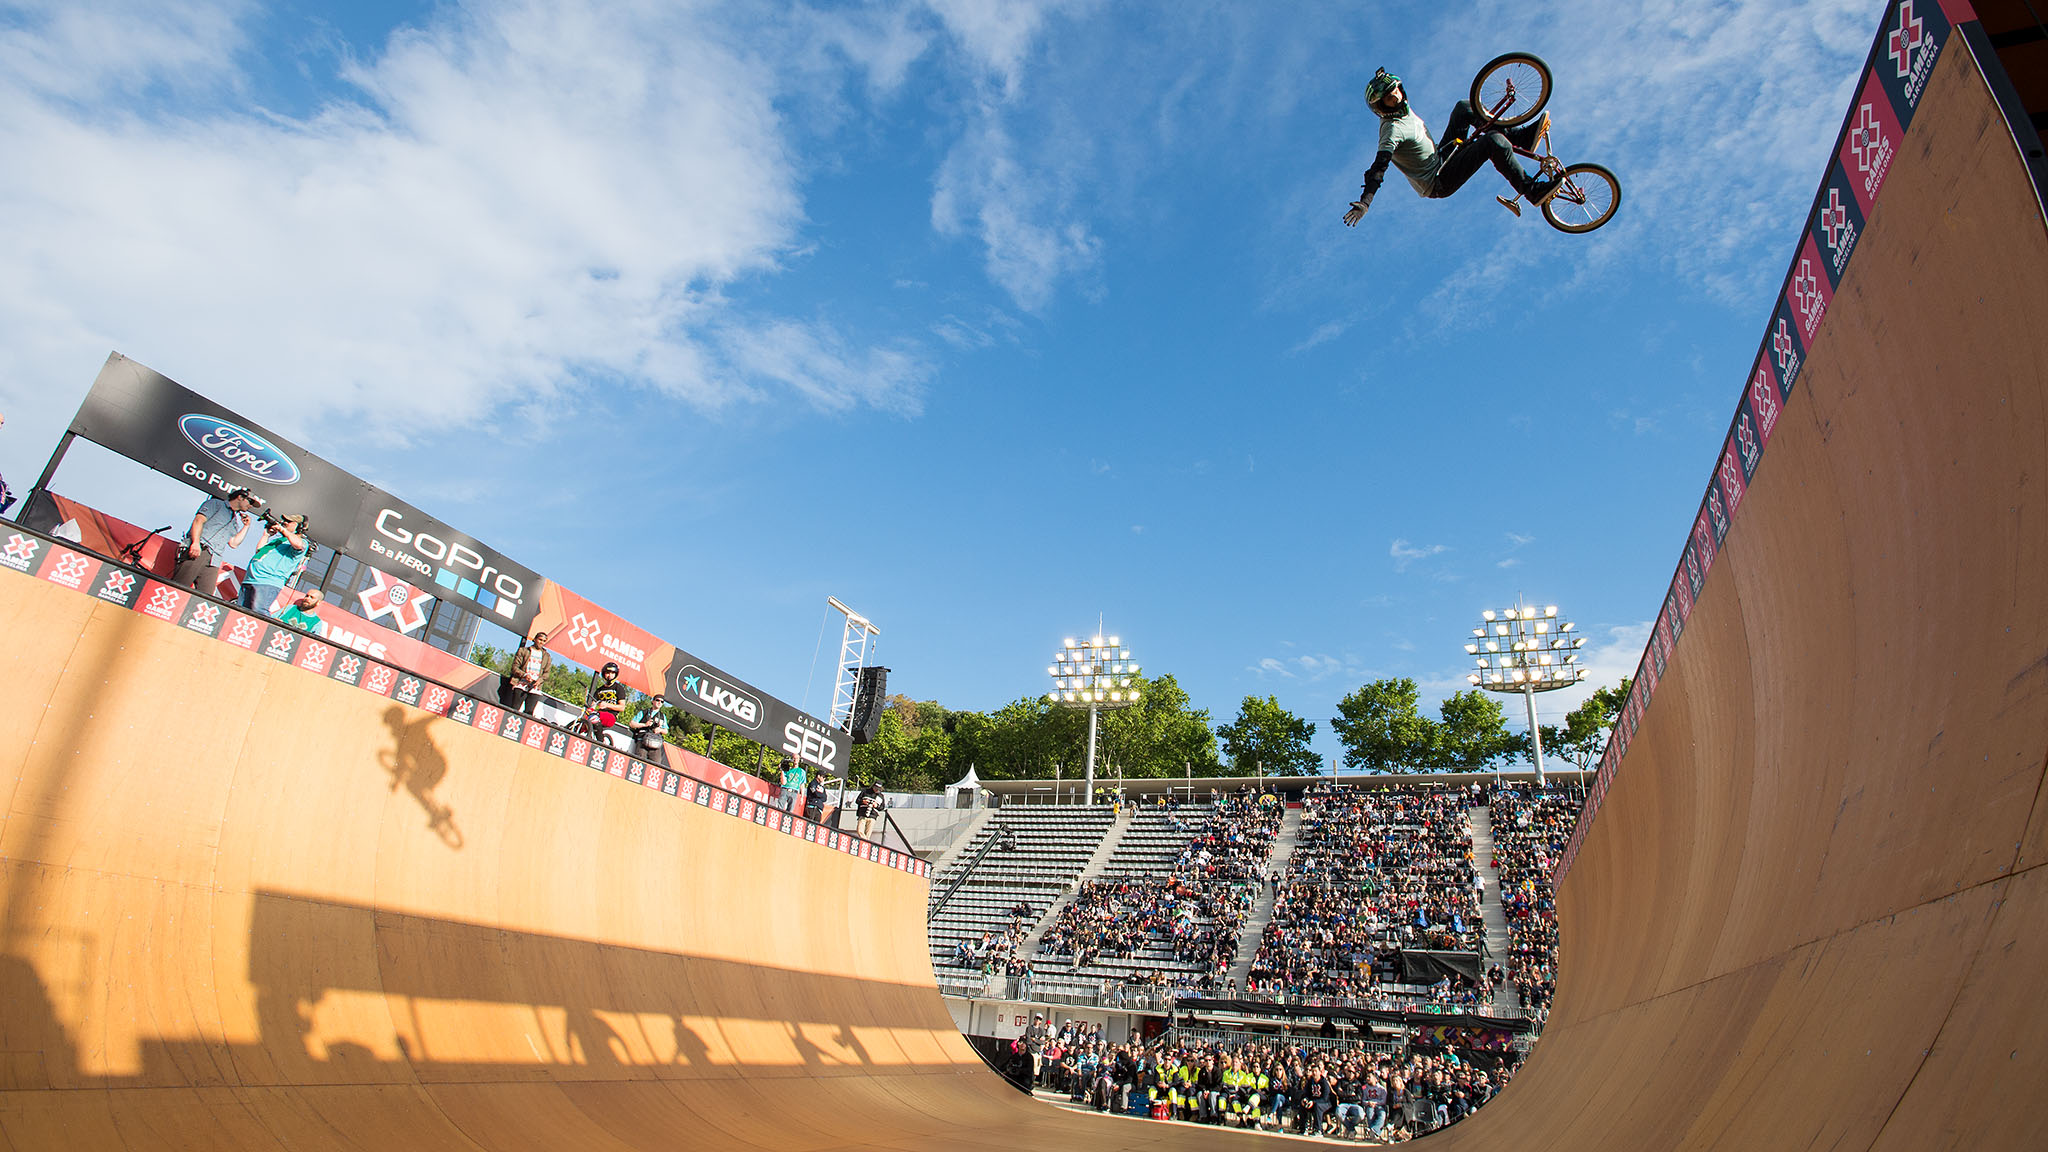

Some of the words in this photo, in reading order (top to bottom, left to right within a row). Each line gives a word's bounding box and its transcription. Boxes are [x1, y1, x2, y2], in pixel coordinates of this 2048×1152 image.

[1904, 31, 1934, 99] GAMES
[1909, 45, 1938, 108] BARCELONA
[1864, 135, 1889, 192] GAMES
[1869, 148, 1894, 200] BARCELONA
[1833, 219, 1854, 267] GAMES
[1805, 290, 1823, 331] GAMES
[182, 462, 207, 481] Go
[202, 427, 279, 475] Ford
[369, 539, 385, 554] Be
[385, 550, 395, 559] a
[375, 509, 523, 600] GoPro
[50, 570, 81, 585] GAMES
[99, 587, 129, 602] GAMES
[145, 603, 173, 617] GAMES
[318, 619, 387, 660] AMES
[599, 646, 641, 672] BARCELONA
[602, 633, 645, 662] GAMES
[782, 721, 837, 771] SER
[798, 715, 831, 737] CADENA
